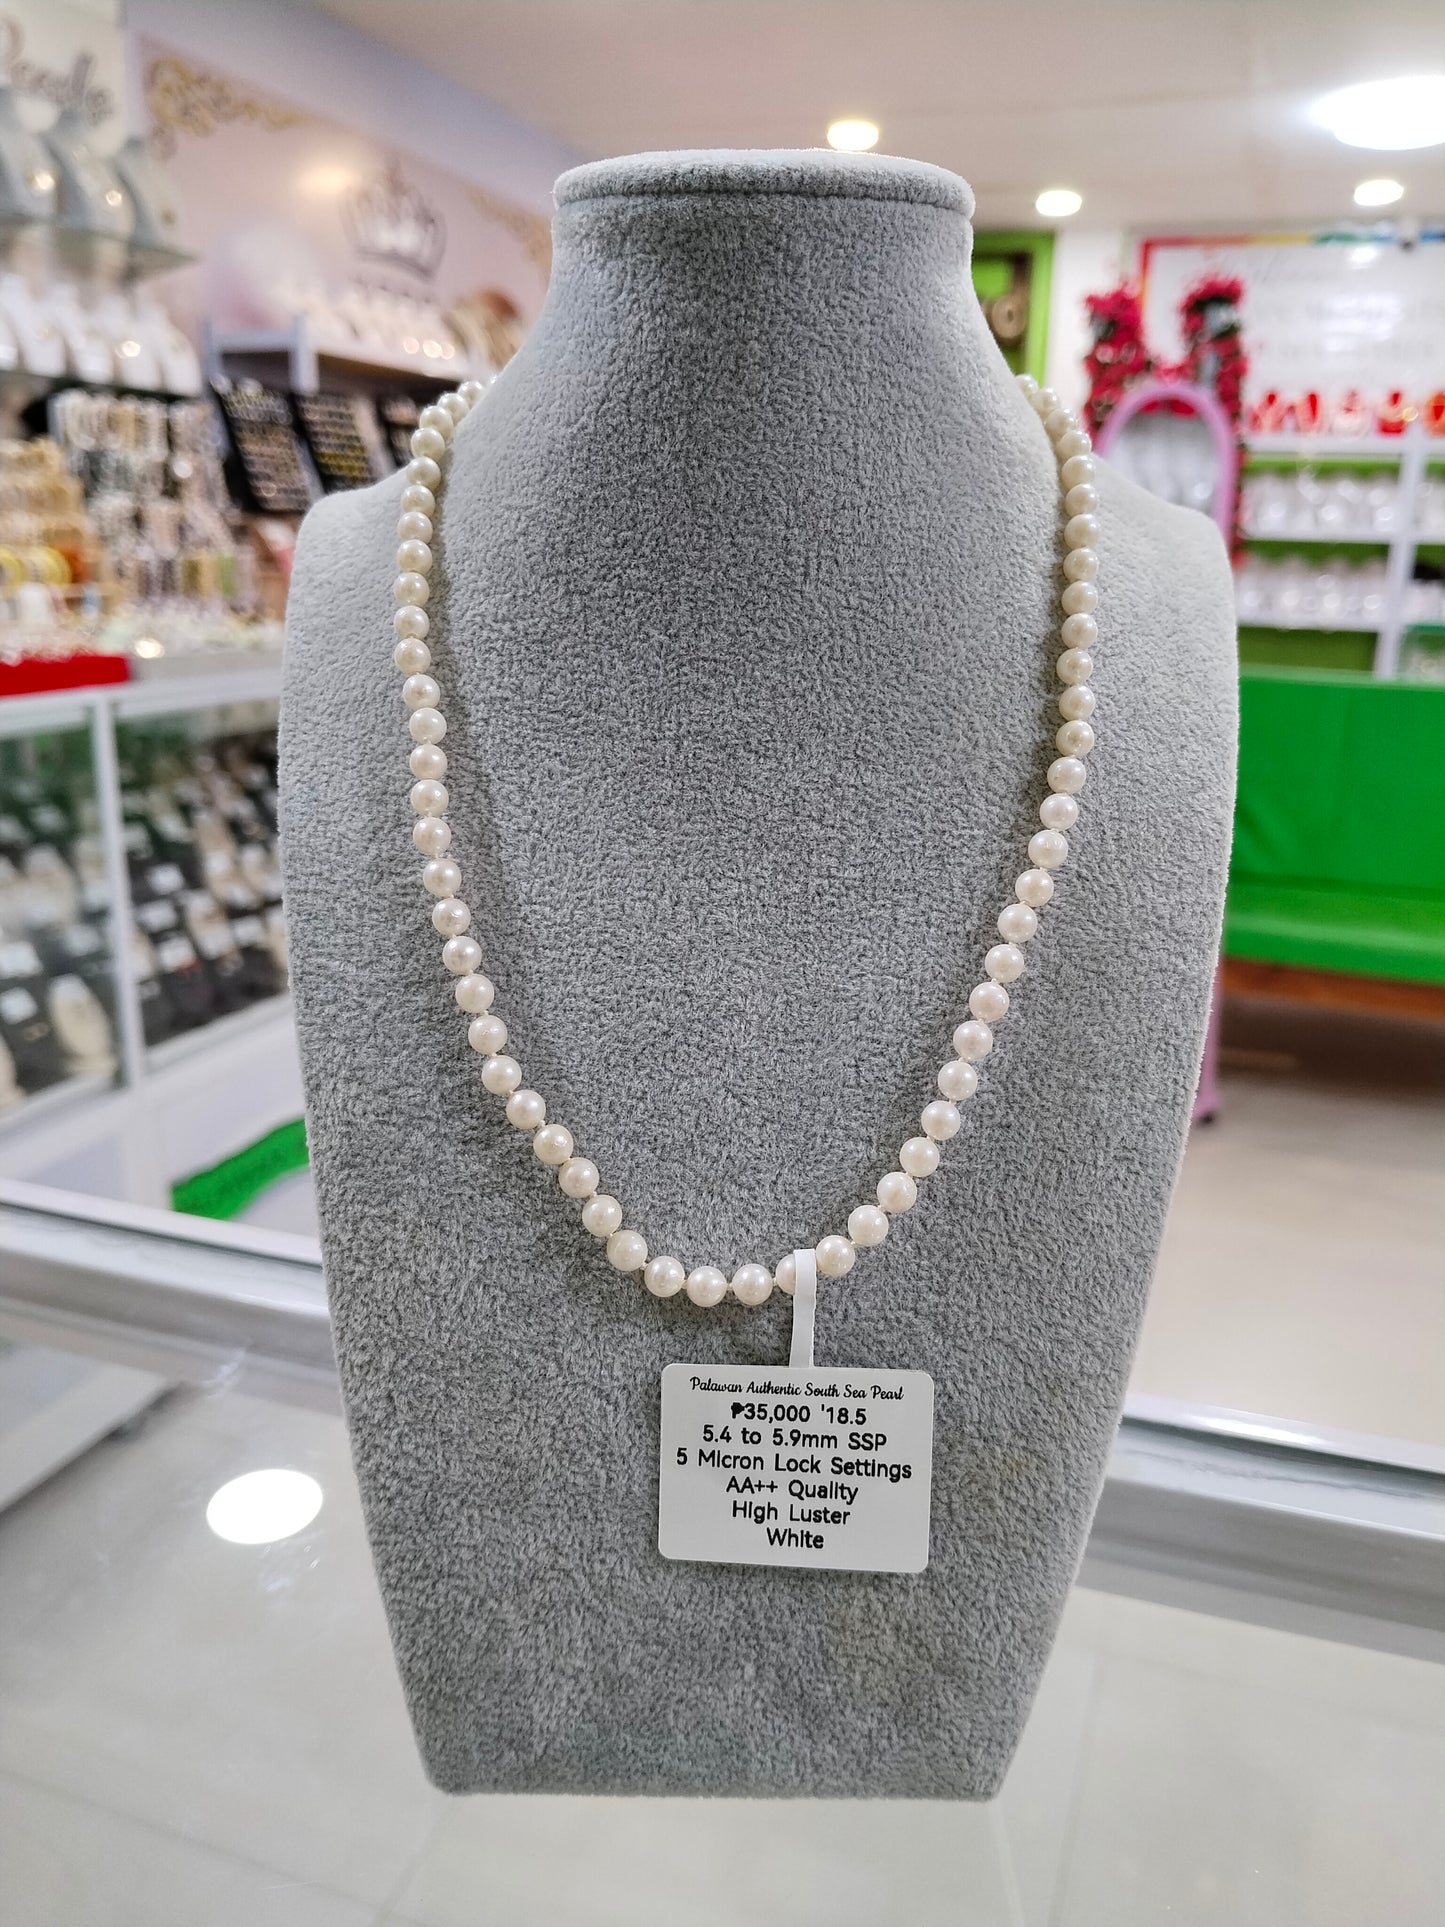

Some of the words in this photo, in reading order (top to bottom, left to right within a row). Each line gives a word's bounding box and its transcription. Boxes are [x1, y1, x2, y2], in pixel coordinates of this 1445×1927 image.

[690, 1376, 743, 1392] Palawan
[745, 1380, 802, 1396] Authentic
[804, 1382, 840, 1397] South
[843, 1383, 868, 1399] Sea
[870, 1385, 905, 1401] Pearl
[821, 1403, 867, 1426] '18.5
[702, 1423, 733, 1444] 5.4
[740, 1427, 762, 1445] to
[772, 1427, 838, 1450] 5.9mm
[847, 1431, 887, 1452] SSP
[676, 1446, 688, 1466] 5
[698, 1448, 765, 1471] Micron
[774, 1452, 822, 1474] Lock
[830, 1456, 912, 1484] Settings
[725, 1475, 779, 1495] AA++
[788, 1478, 859, 1506] Quality
[732, 1499, 778, 1525] High
[789, 1503, 851, 1526] Luster
[766, 1526, 825, 1550] White
